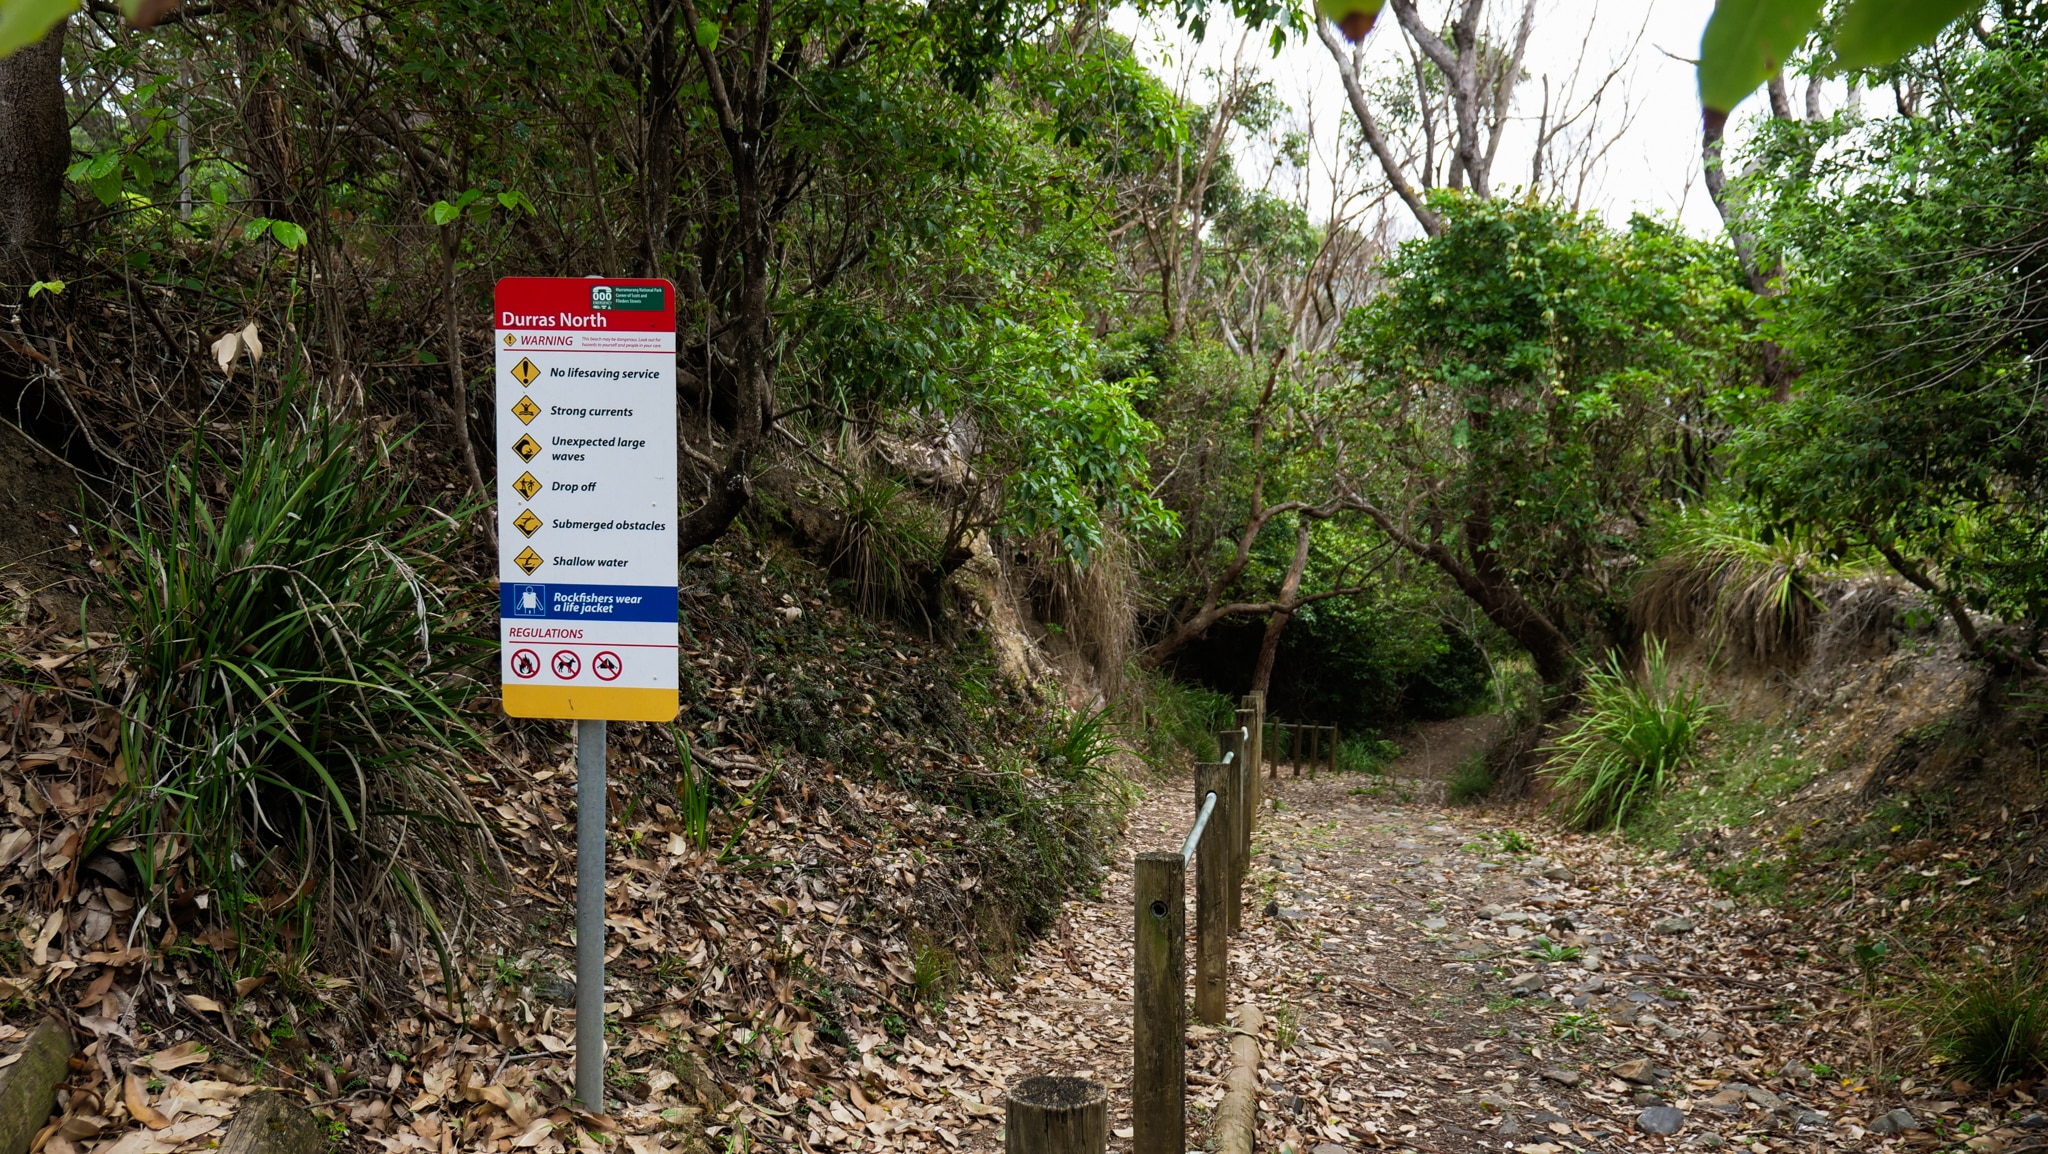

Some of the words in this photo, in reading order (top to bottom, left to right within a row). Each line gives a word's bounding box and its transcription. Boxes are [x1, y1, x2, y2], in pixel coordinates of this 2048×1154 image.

[502, 312, 556, 326] Durras
[560, 312, 607, 327] North
[521, 336, 573, 346] WARNING
[550, 368, 565, 377] No
[568, 368, 619, 380] lifesaving
[622, 369, 659, 379] service
[551, 406, 586, 418] Strong
[589, 407, 633, 416] currents
[552, 436, 615, 448] Unexpected
[617, 437, 645, 449] large
[552, 453, 585, 461] waves
[552, 482, 579, 493] Drop
[581, 482, 597, 491] off
[552, 519, 613, 531] Submerged
[616, 521, 666, 530] obstacles
[553, 557, 595, 566] Shallow
[598, 559, 628, 567] water
[554, 593, 614, 603] Rockfishers
[563, 602, 579, 612] life
[580, 603, 613, 614] jacket
[509, 628, 583, 638] REGULATIONS
